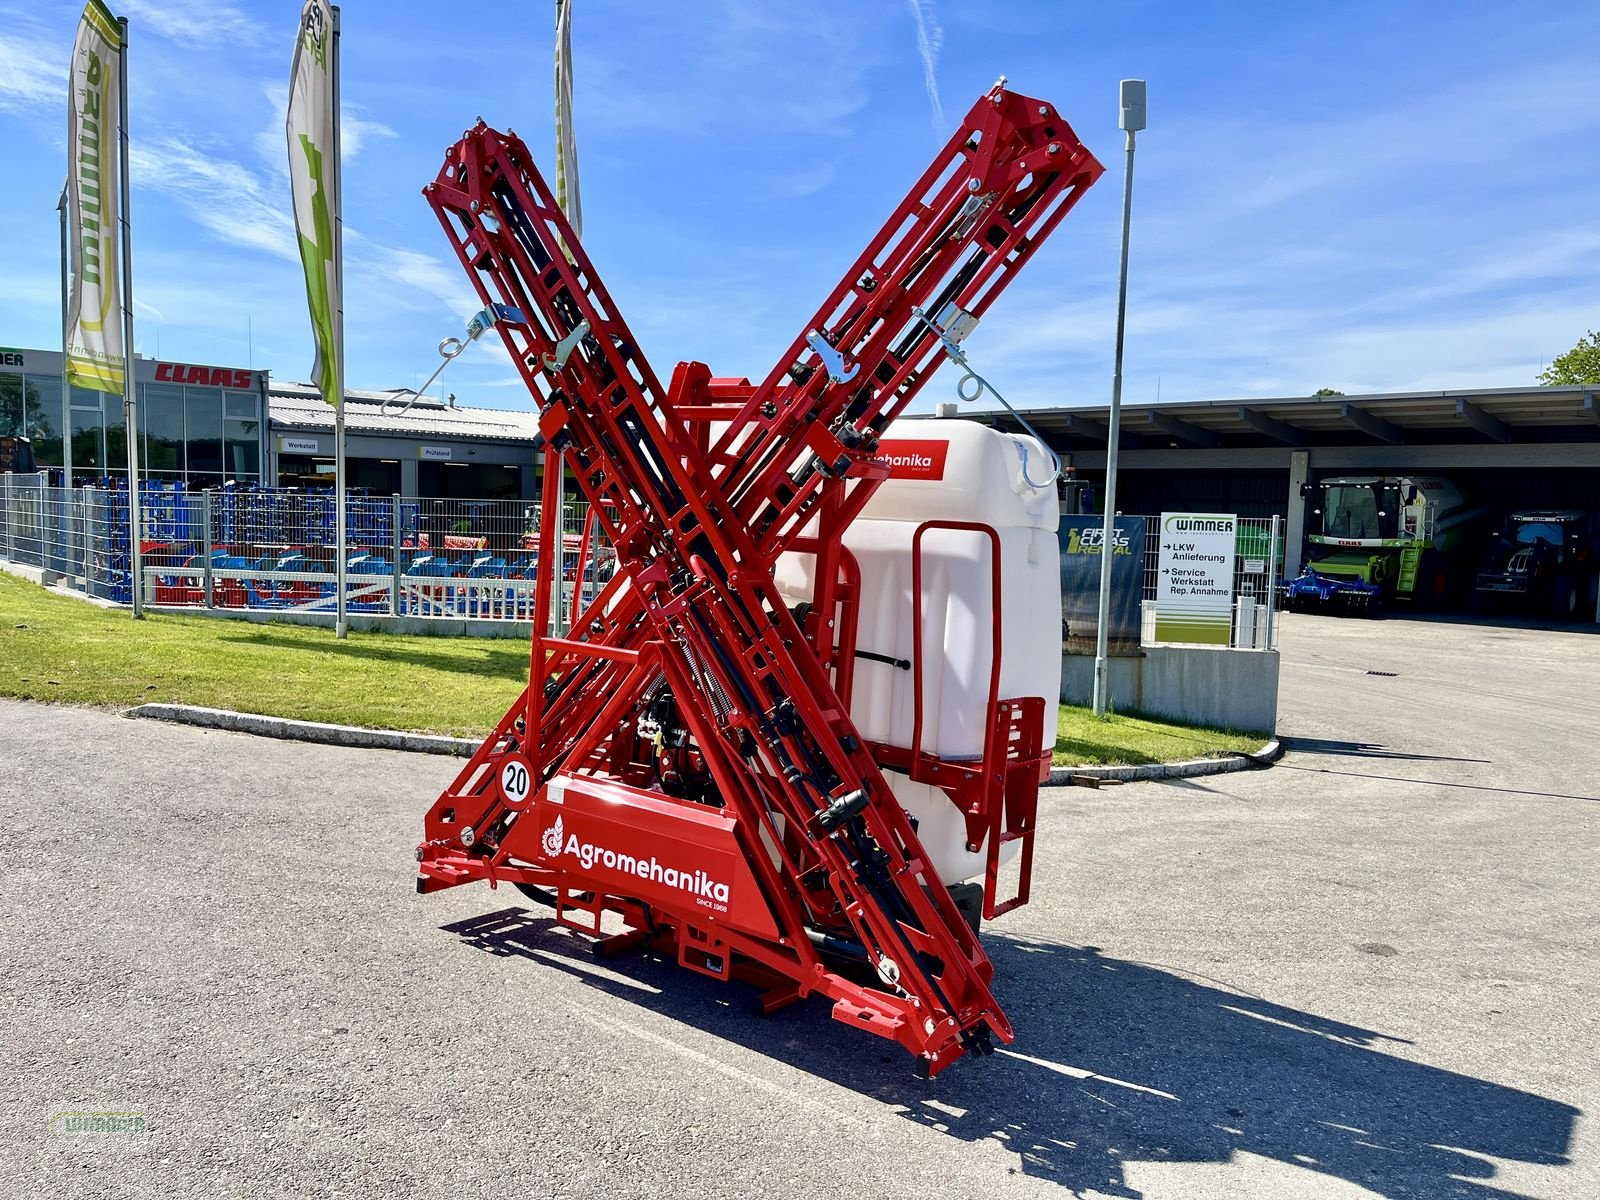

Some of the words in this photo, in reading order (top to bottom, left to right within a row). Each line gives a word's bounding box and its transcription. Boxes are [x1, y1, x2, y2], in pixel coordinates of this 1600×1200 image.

[155, 364, 251, 388] CLAAS
[287, 441, 316, 450] Werkstatt
[425, 449, 450, 457] Prüfstand
[1176, 520, 1233, 532] WIMMER
[1082, 528, 1124, 537] FIRT
[1173, 543, 1195, 551] LKW
[1172, 553, 1225, 563] Anlieferung
[1171, 567, 1206, 577] Service
[1171, 577, 1214, 586] Werkstatt
[1170, 586, 1188, 596] Rep.
[1190, 587, 1229, 596] Annahme
[505, 764, 526, 796] 20
[564, 834, 729, 903] Agromehanika
[696, 897, 713, 909] SINCE
